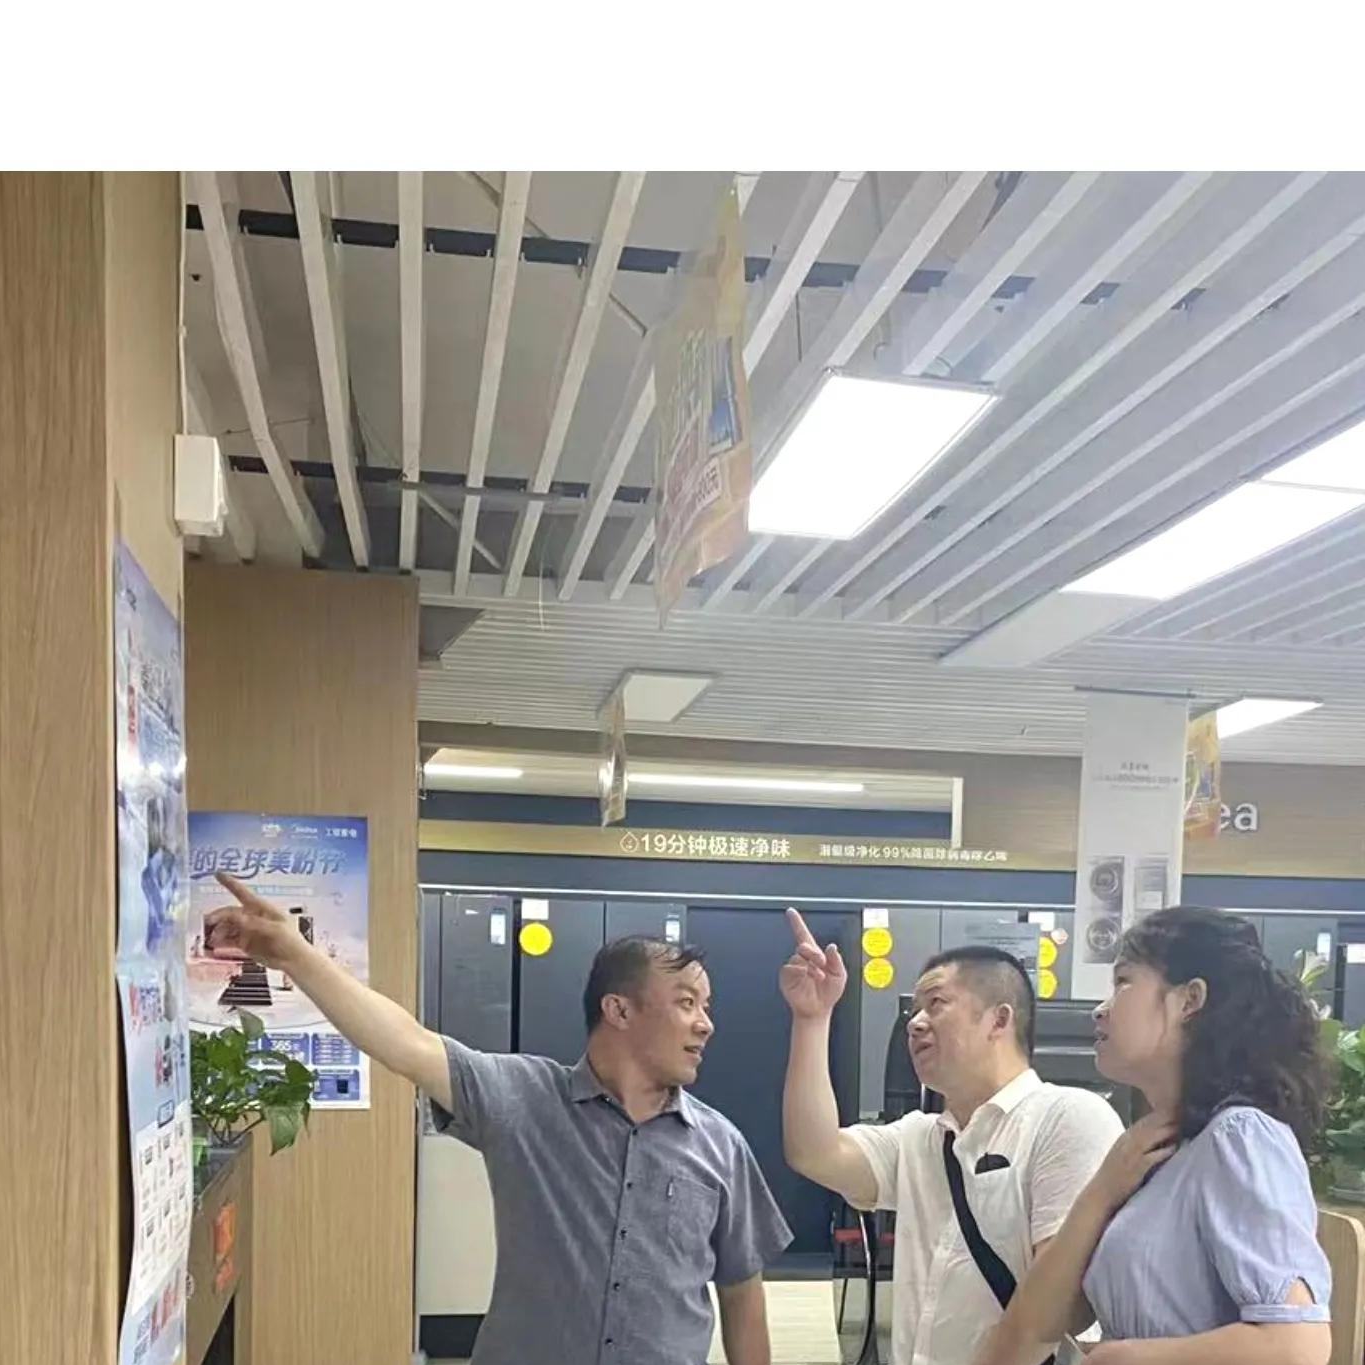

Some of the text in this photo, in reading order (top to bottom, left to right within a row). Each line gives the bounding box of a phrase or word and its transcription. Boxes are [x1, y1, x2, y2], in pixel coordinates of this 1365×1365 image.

[641, 833, 790, 857] 19分钟极速净味
